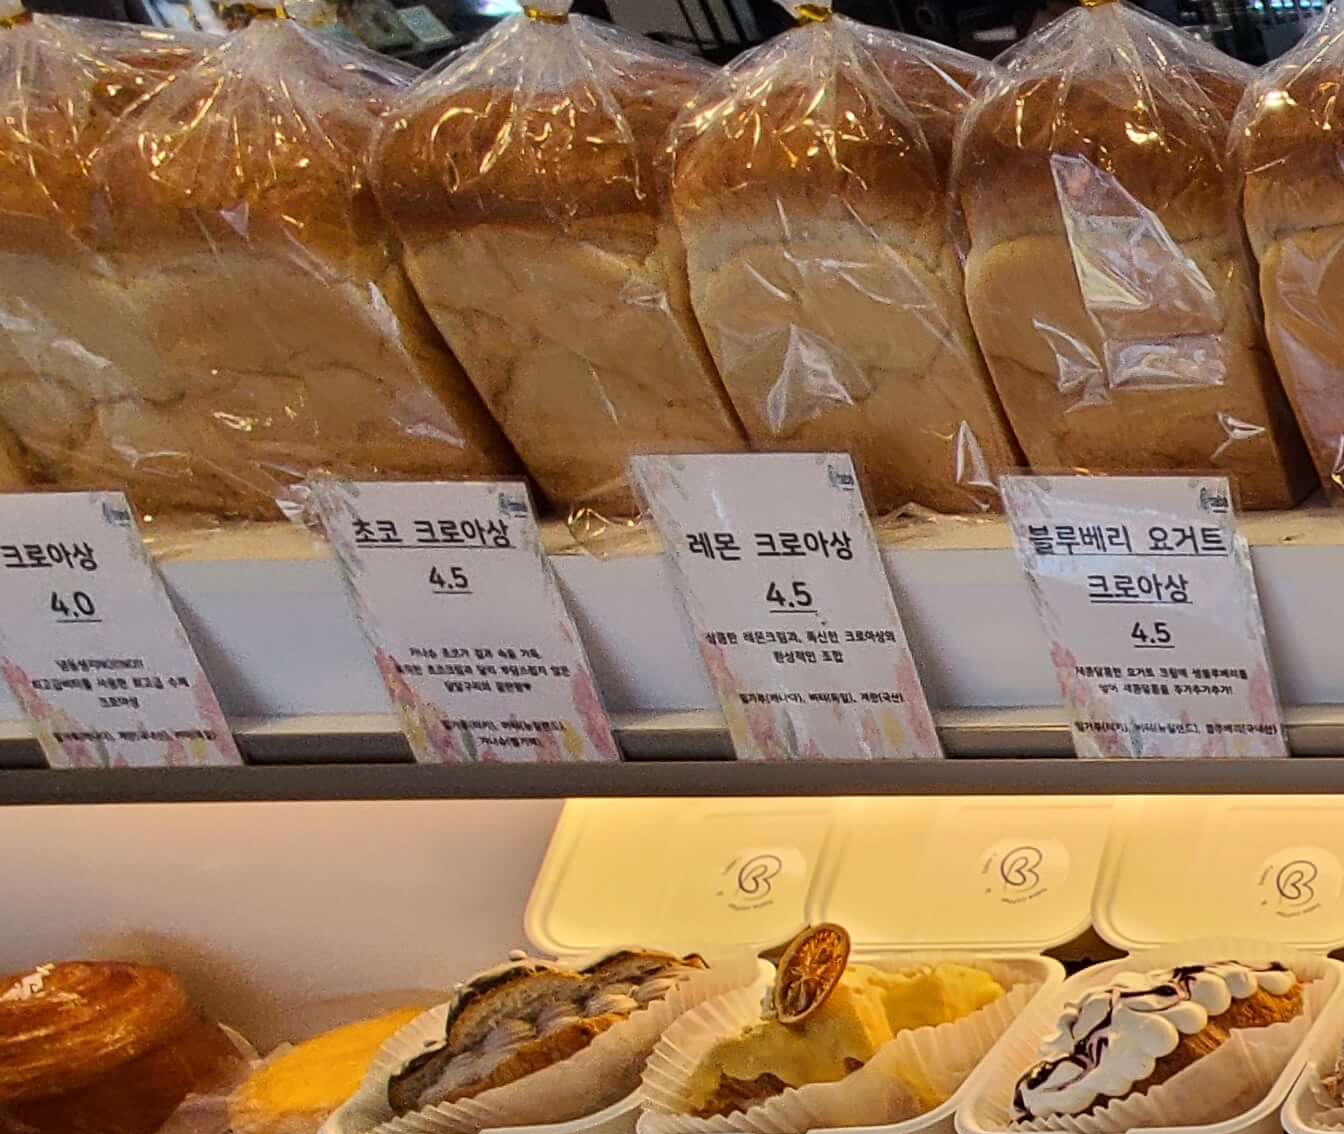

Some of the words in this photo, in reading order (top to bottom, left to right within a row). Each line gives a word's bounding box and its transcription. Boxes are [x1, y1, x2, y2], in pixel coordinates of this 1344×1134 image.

[352, 520, 401, 544] 초코
[414, 519, 511, 546] 크로아상
[686, 531, 741, 561] 레몬
[754, 530, 854, 561] 크로아상
[1028, 525, 1132, 554] 블루베리
[1148, 525, 1227, 552] 요거트
[1, 541, 98, 570] 크로아상
[429, 566, 469, 590] 4.5
[1087, 574, 1190, 602] 크로아상
[50, 590, 96, 618] 4.0
[766, 581, 813, 608] 4.5
[844, 630, 897, 644] 크로아상의
[1131, 621, 1172, 644] 4.5
[822, 650, 844, 664] 조합
